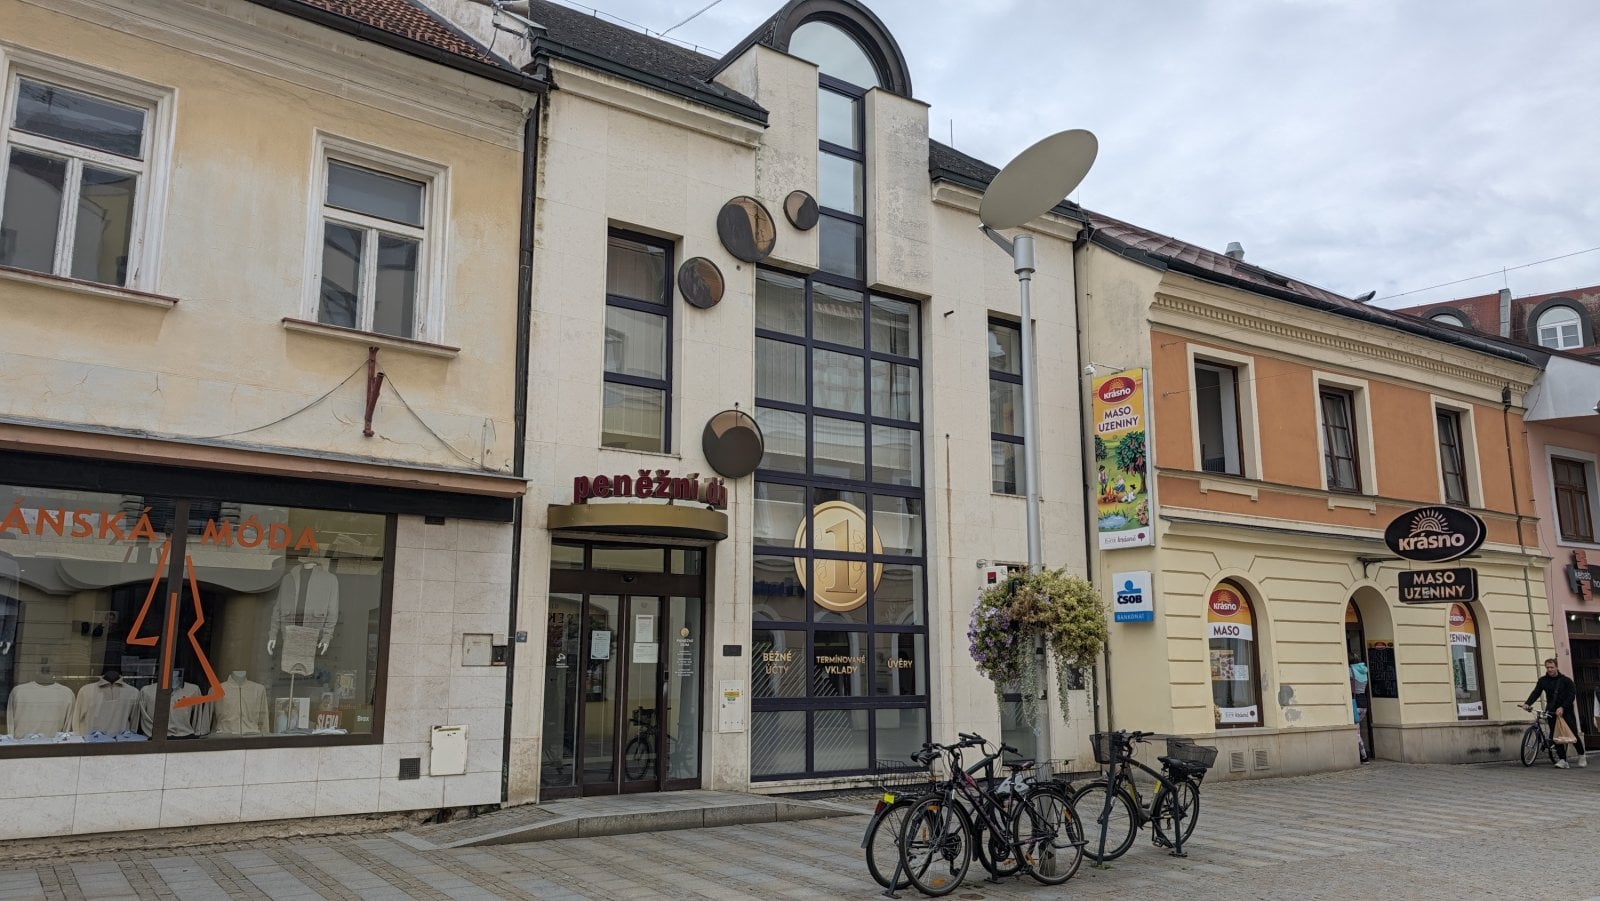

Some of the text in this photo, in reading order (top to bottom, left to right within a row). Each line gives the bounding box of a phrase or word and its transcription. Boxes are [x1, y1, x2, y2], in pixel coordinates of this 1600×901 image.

[1104, 406, 1132, 420] MASO
[1098, 415, 1139, 432] UZENINY
[574, 469, 700, 505] peněžní
[201, 514, 320, 553] MÓDA
[825, 519, 857, 593] 1
[1413, 571, 1456, 585] MASO
[1117, 592, 1143, 605] ČSOB
[1404, 585, 1466, 599] UZENINY
[1213, 625, 1240, 636] MASO
[762, 649, 793, 662] BĚŽNÉ
[816, 654, 866, 664] TERMÍNOVANÉ
[765, 663, 789, 675] ÚČTY
[887, 657, 913, 669] ÚVĚRY
[825, 665, 858, 675] VKLADY
